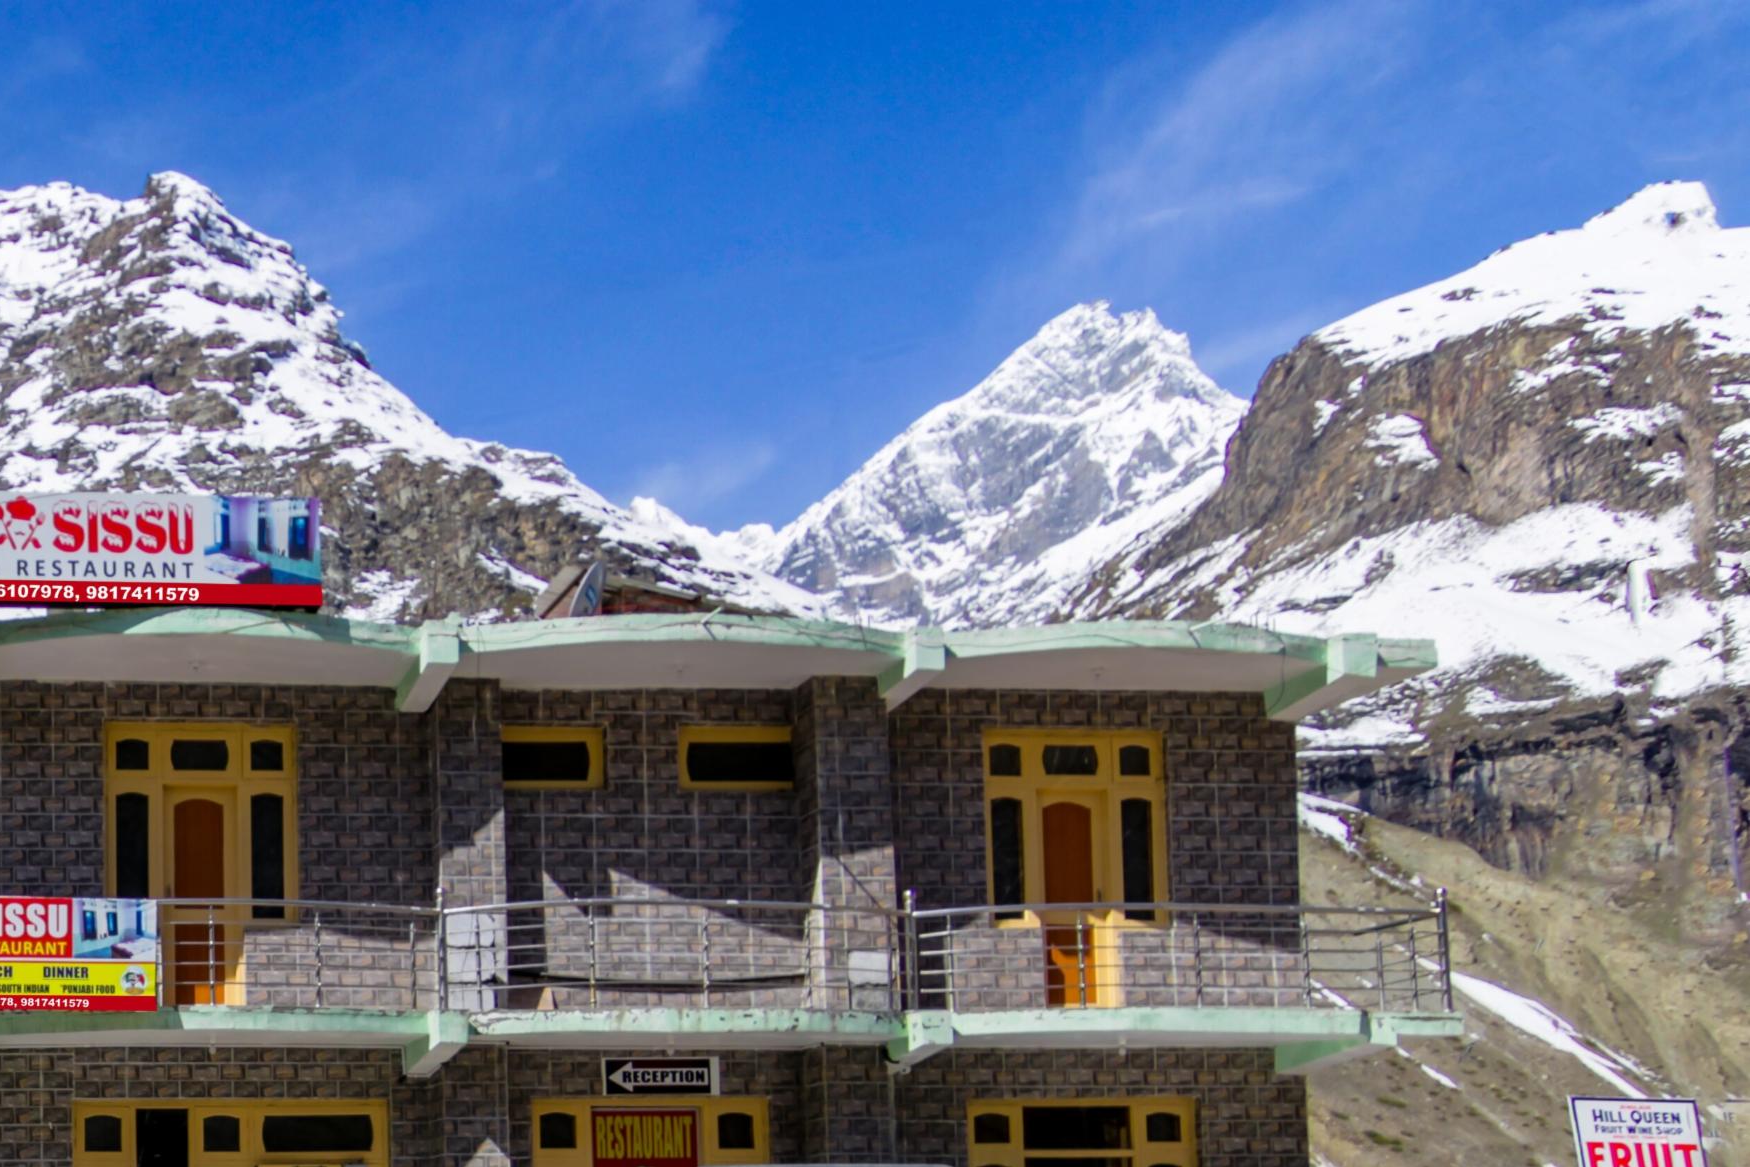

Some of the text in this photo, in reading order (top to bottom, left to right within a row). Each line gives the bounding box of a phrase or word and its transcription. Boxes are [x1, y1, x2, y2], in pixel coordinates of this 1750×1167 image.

[52, 500, 194, 554] SISSU
[17, 559, 194, 579] RESTAURANT
[86, 585, 200, 602] 9817411579
[43, 966, 89, 979] DINNER
[21, 998, 90, 1008] 9817411579
[622, 1070, 705, 1084] RECEPTION
[1592, 1109, 1681, 1124] HILL QUEEN
[595, 1115, 693, 1159] RESTAURANT
[1595, 1125, 1622, 1134] FRUIT
[1627, 1126, 1653, 1134] WINE
